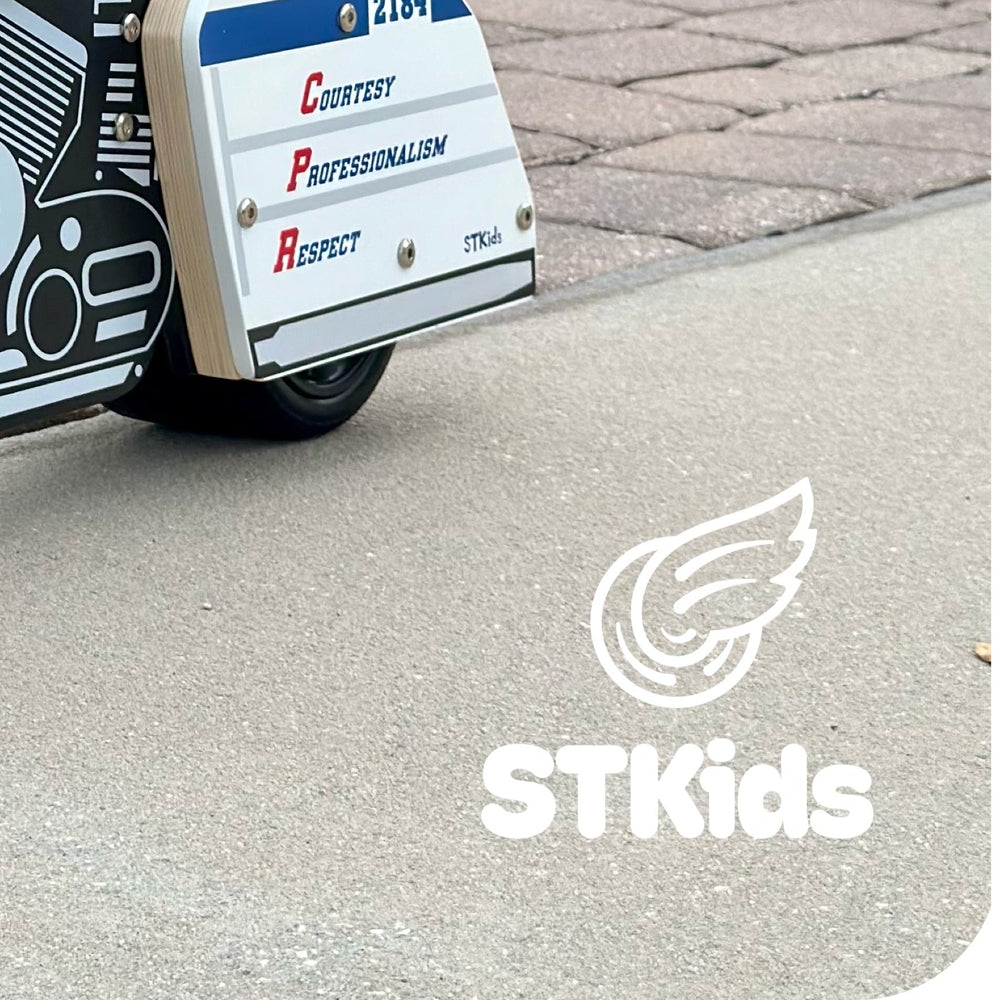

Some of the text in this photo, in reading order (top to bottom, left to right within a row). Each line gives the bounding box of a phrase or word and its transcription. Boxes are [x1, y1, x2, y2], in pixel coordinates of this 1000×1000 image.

[300, 71, 396, 115] COURTESY
[286, 134, 448, 193] PROFESSIONALISM
[272, 226, 361, 273] RESPECT
[463, 226, 502, 254] STKids
